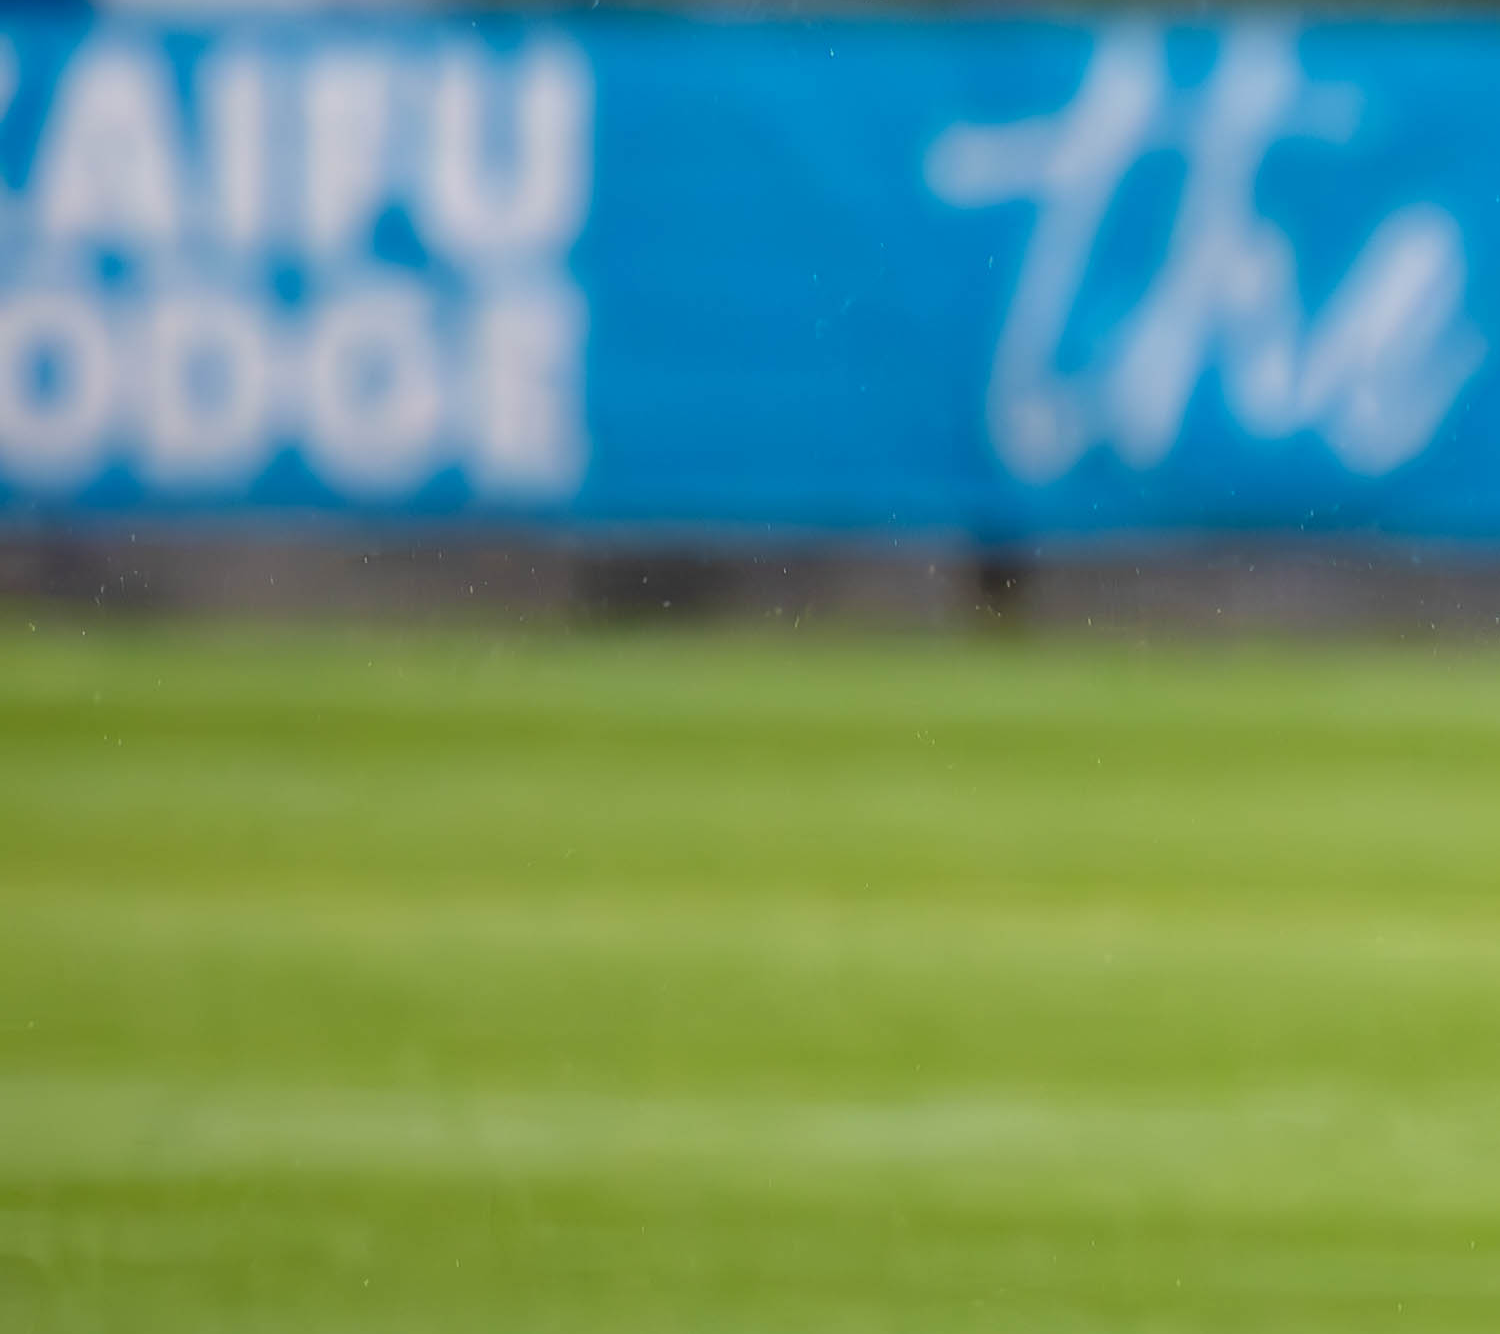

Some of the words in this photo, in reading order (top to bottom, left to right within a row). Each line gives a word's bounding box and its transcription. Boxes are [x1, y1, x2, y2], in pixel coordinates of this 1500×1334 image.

[0, 27, 592, 262] AIFU
[925, 12, 1492, 485] the
[0, 267, 592, 492] ODGE
